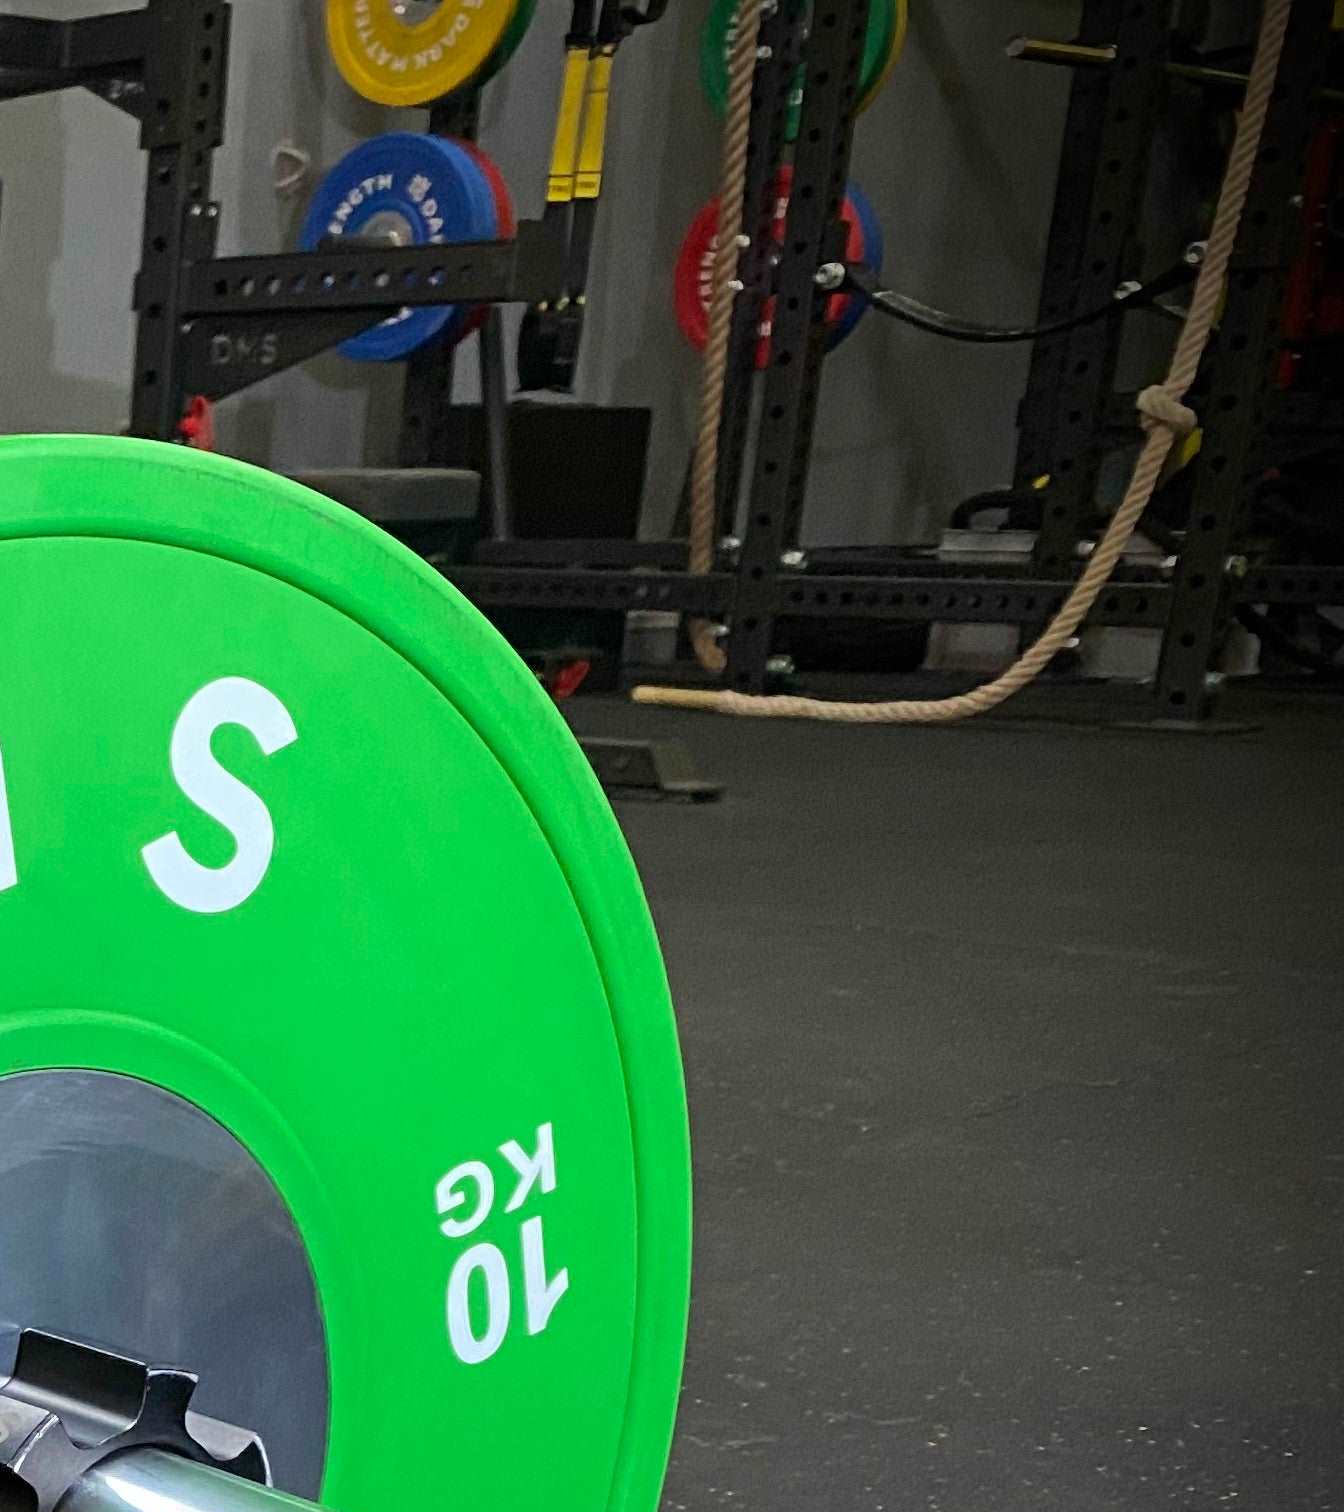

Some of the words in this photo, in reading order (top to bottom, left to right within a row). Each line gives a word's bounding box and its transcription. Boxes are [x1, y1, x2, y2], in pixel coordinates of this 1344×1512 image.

[209, 333, 278, 366] DMS
[434, 1122, 558, 1239] KG
[446, 1215, 570, 1363] 10
